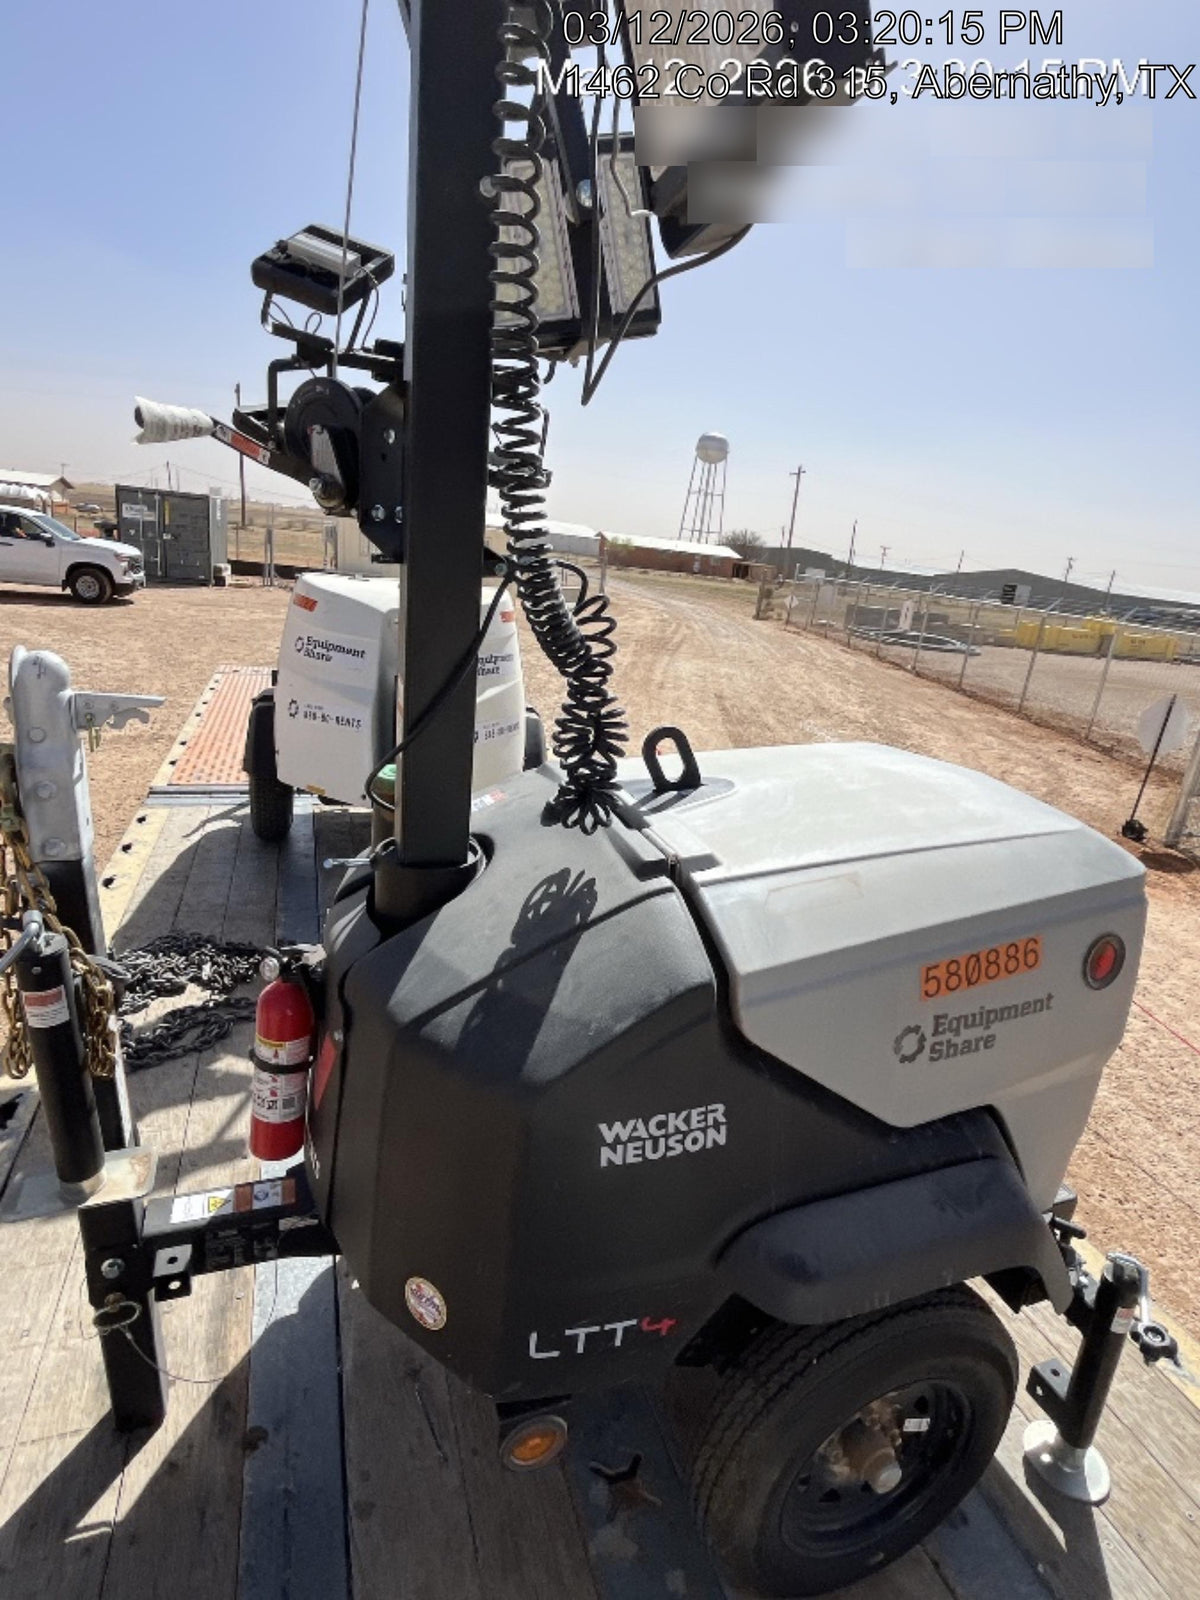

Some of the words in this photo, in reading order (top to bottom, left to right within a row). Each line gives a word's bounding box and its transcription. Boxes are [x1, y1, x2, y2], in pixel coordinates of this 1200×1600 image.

[923, 937, 1041, 999] 580886
[930, 992, 1055, 1037] Equipment
[928, 1033, 997, 1063] Share
[597, 1102, 728, 1145] WACKER
[599, 1124, 728, 1168] NEUSON
[528, 1316, 677, 1360] LTT4
